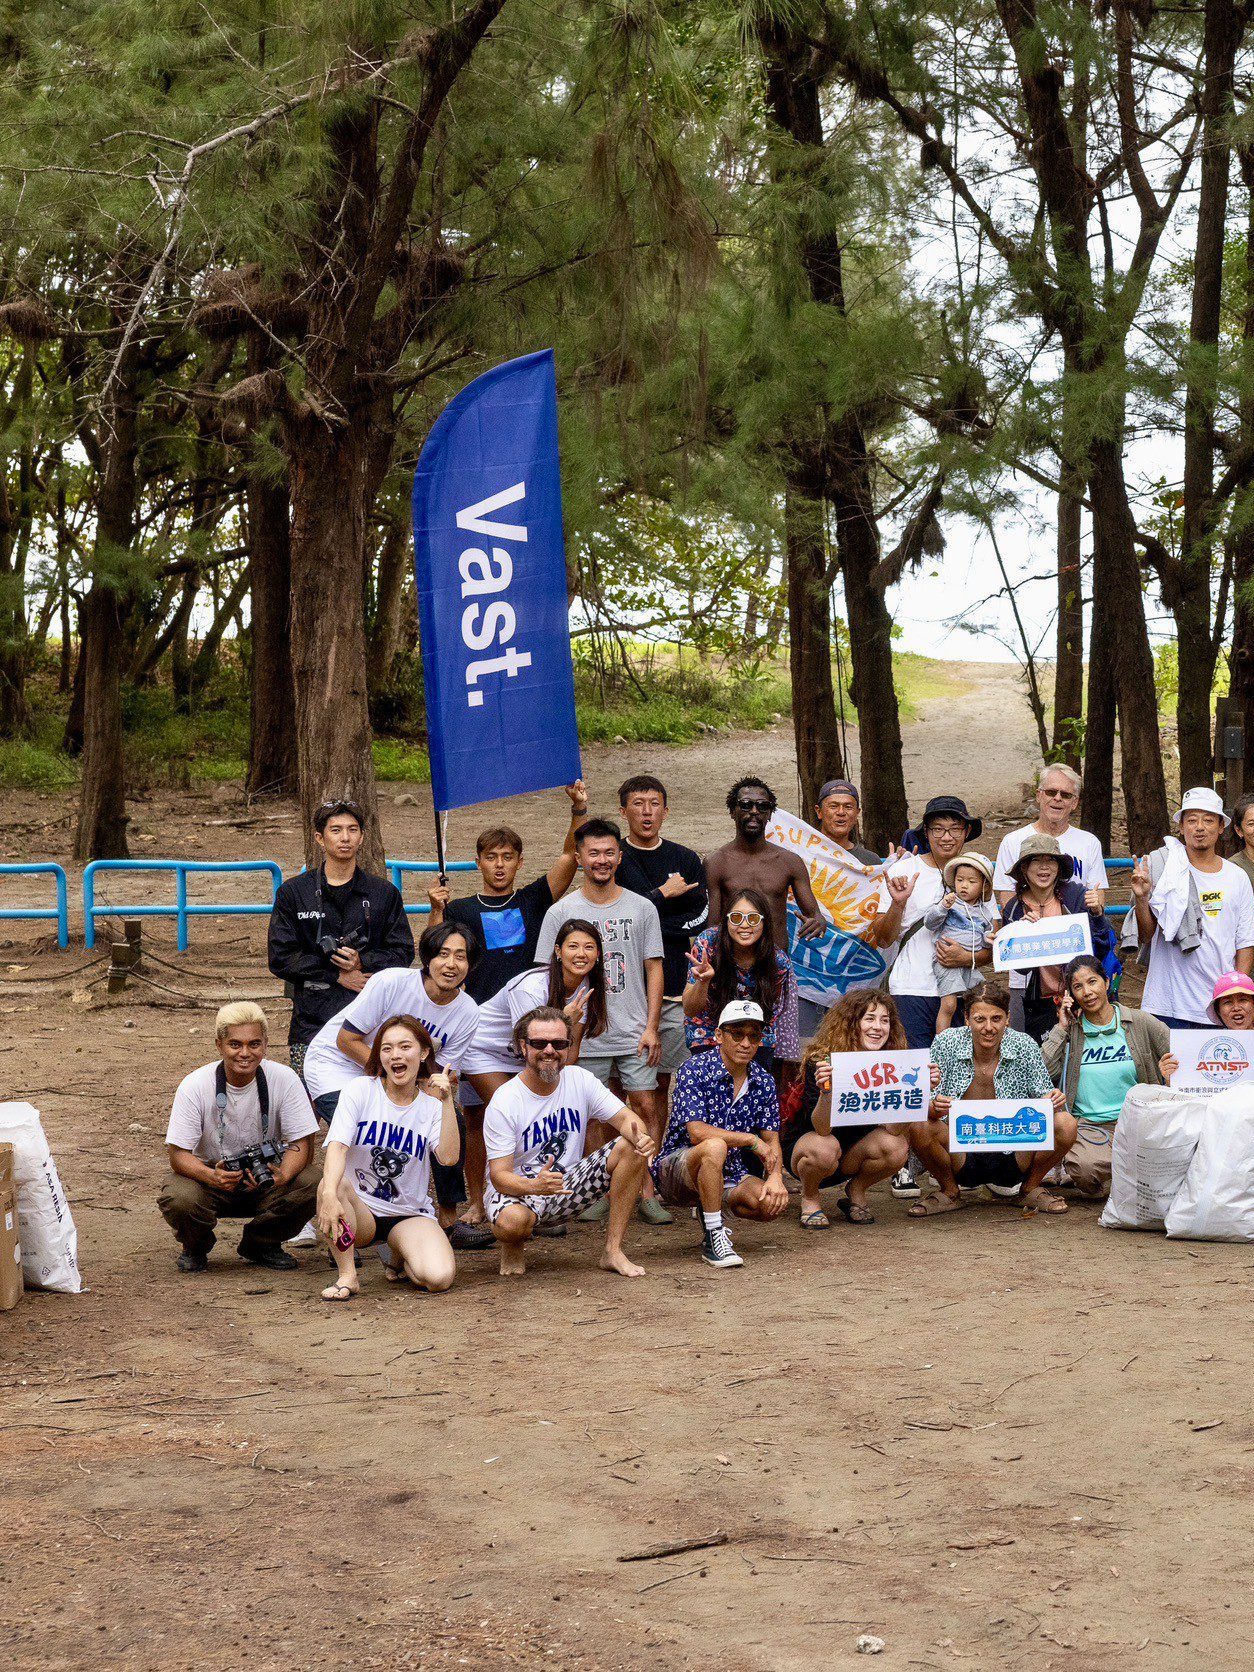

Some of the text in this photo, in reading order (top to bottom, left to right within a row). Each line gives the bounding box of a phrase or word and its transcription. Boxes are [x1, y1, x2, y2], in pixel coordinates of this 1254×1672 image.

[456, 481, 532, 707] Vast.
[1202, 892, 1221, 901] DGK
[853, 1063, 899, 1089] USR
[838, 1088, 923, 1113] 漁光再造
[355, 1121, 427, 1161] TAIWAN
[521, 1107, 581, 1152] TAIWAN
[961, 1121, 1041, 1136] 南臺科技大學
